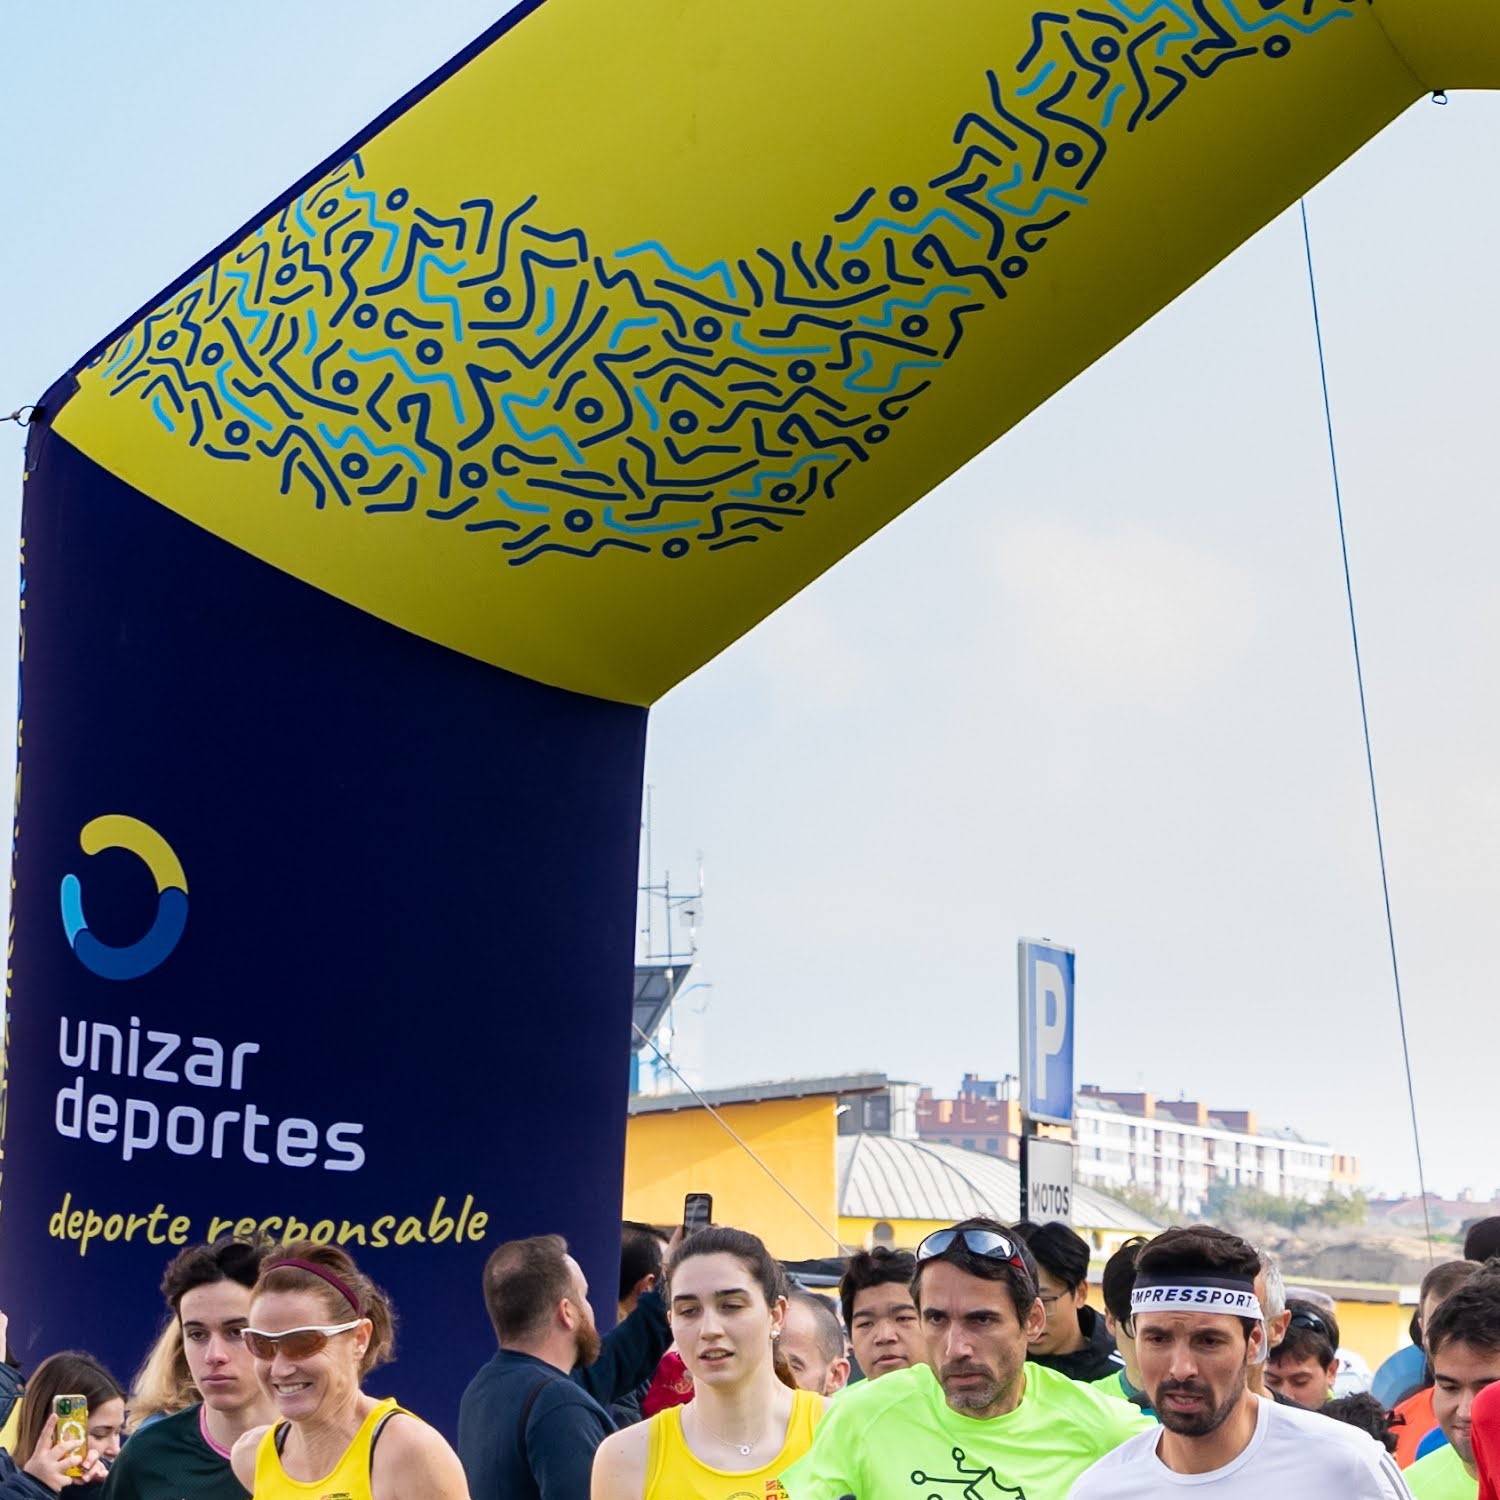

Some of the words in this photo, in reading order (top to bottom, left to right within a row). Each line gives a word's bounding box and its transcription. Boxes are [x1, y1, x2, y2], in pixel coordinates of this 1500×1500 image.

[61, 1016, 260, 1091] unizar
[1035, 959, 1067, 1100] P
[54, 1076, 367, 1172] deportes
[48, 1192, 190, 1256] deporte
[206, 1194, 489, 1250] responsable
[1031, 1182, 1070, 1216] MOTOS
[1132, 1288, 1253, 1308] MPRESSPORT
